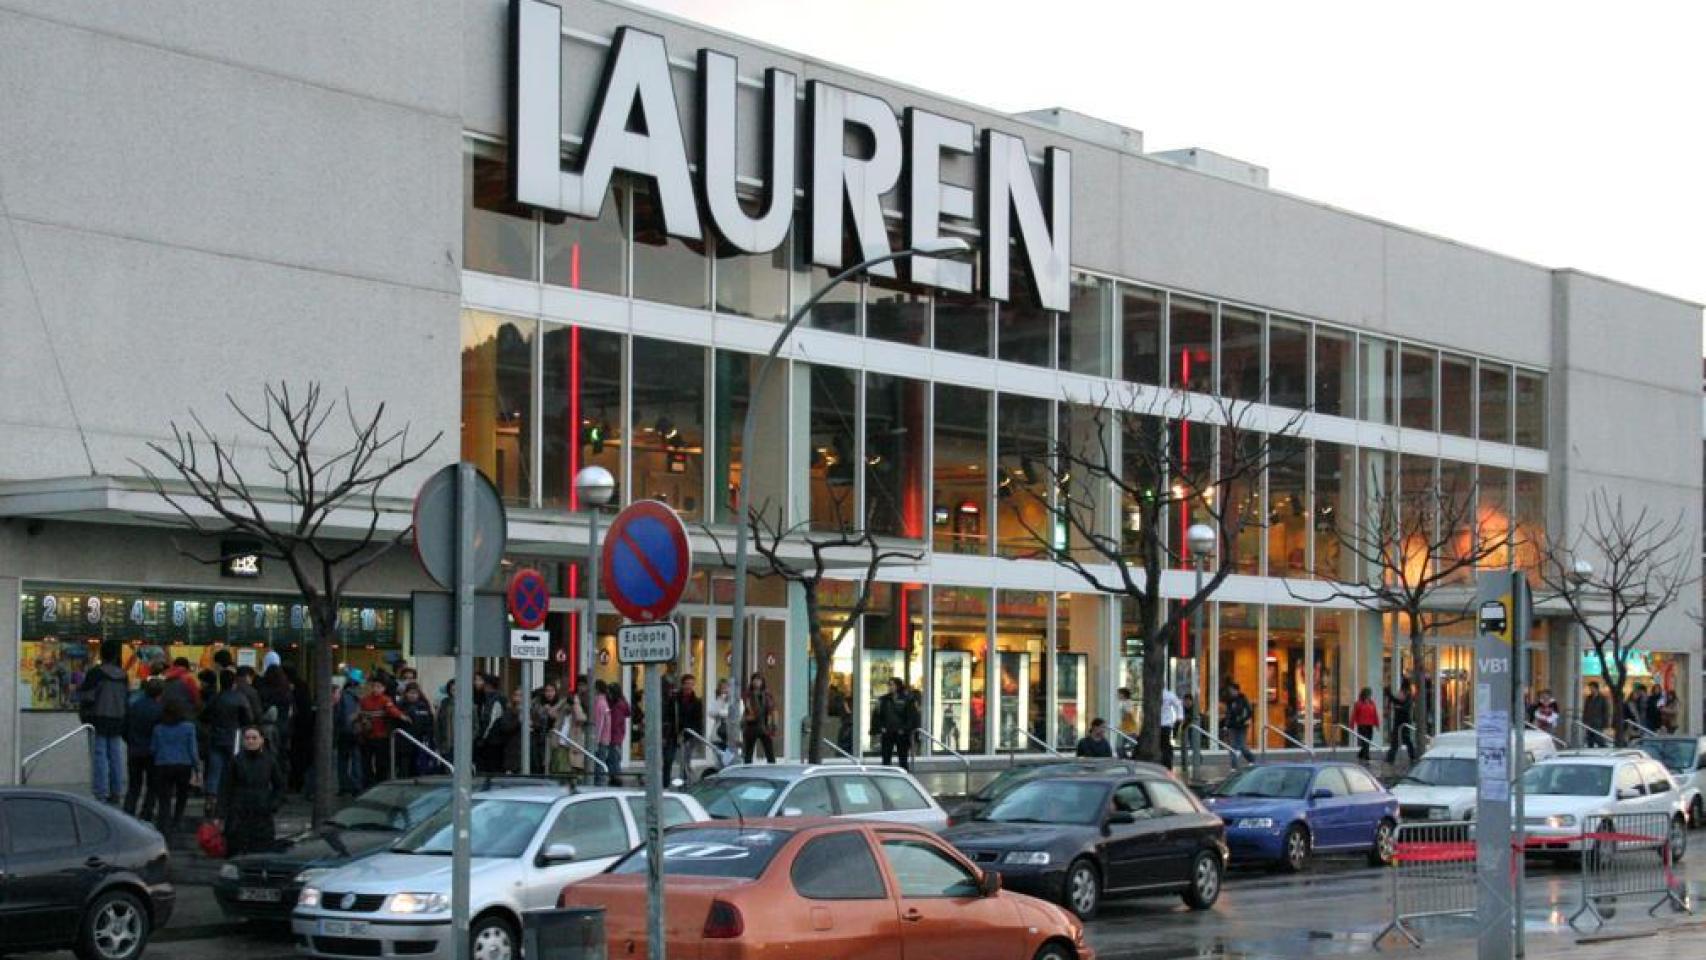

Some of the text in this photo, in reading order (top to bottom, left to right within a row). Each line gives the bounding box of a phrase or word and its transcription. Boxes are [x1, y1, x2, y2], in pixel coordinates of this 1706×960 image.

[509, 0, 1072, 313] LAUREN
[43, 595, 57, 622] 2
[87, 596, 101, 624] 3
[130, 599, 144, 626] 4
[173, 600, 186, 627] 5
[214, 601, 226, 627] 6
[252, 603, 265, 629] 7
[622, 646, 671, 657] Turismes
[1478, 658, 1508, 673] VB1
